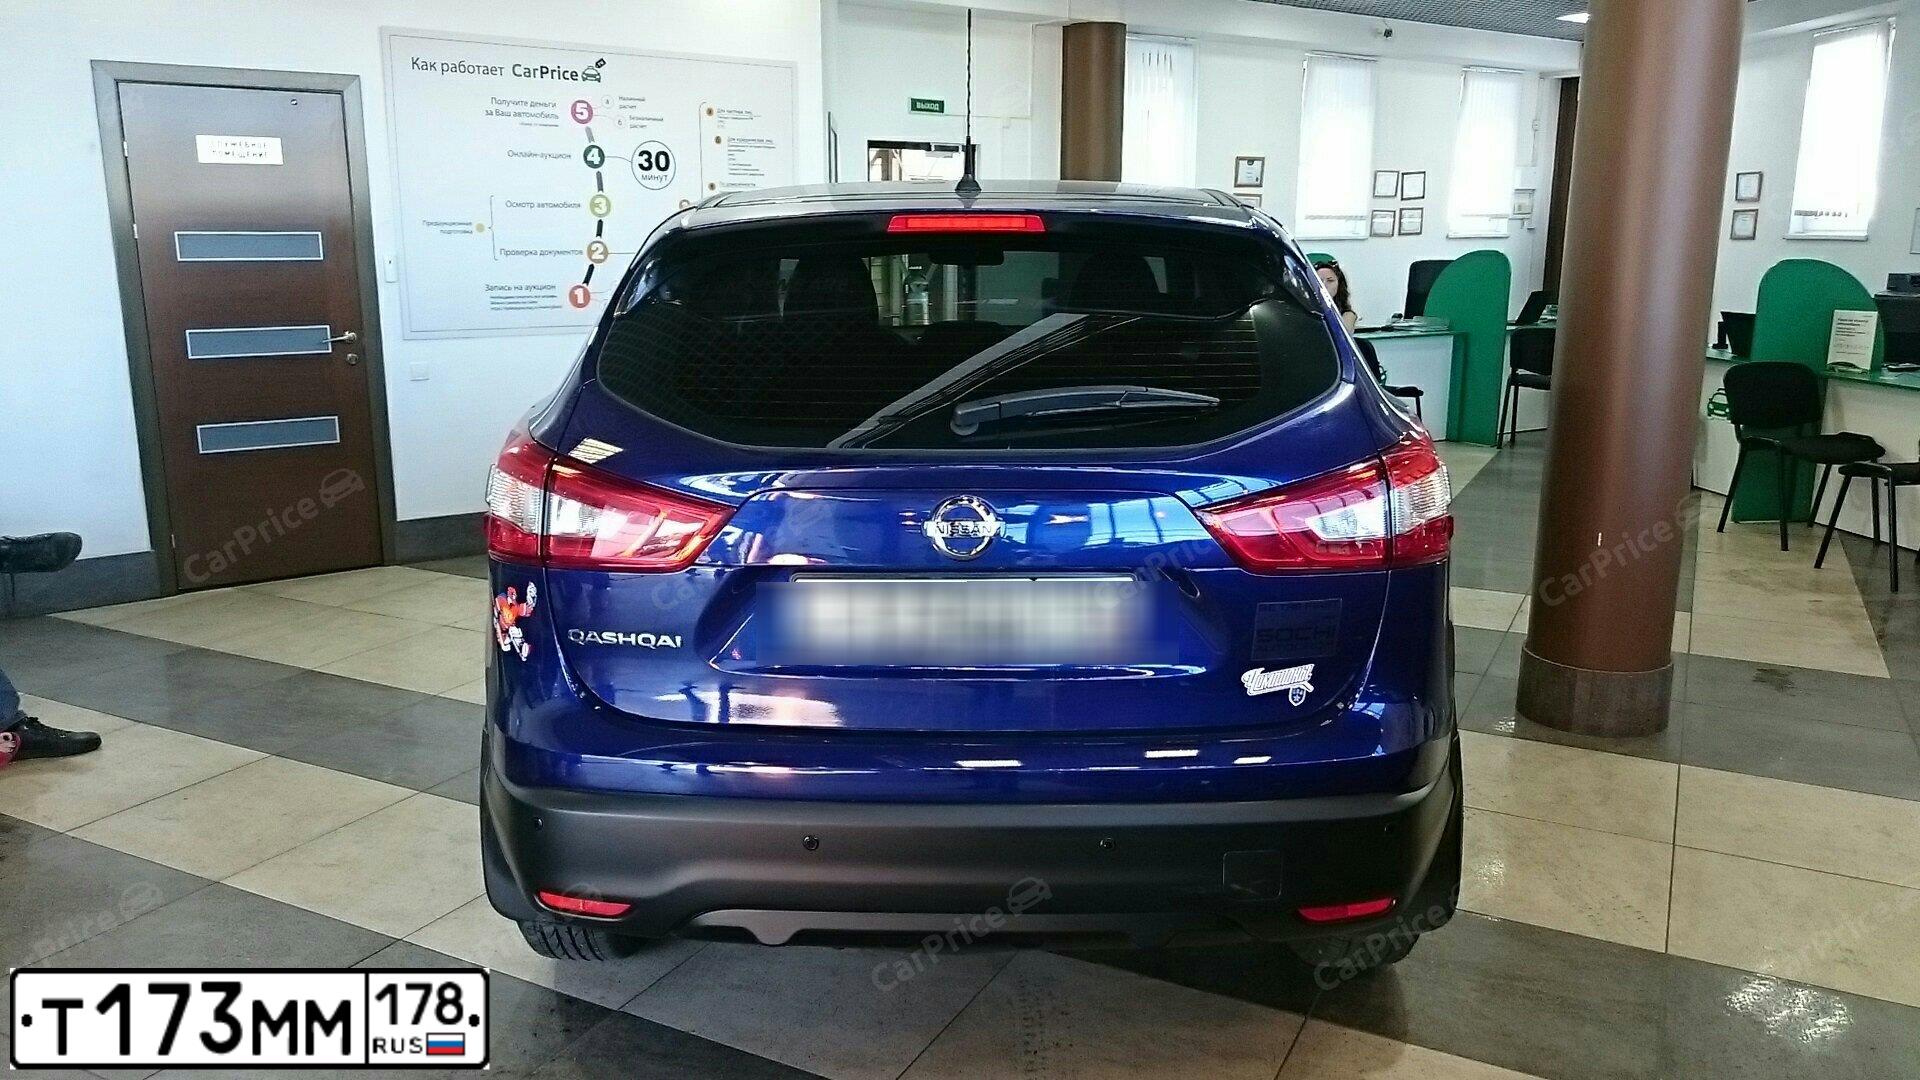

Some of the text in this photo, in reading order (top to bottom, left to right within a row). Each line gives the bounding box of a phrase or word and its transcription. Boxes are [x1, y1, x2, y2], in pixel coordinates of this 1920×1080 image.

[411, 56, 505, 76] Как работает
[512, 63, 579, 81] CarPrice
[491, 97, 529, 108] Получите
[575, 102, 590, 122] 5
[587, 148, 601, 165] 4
[637, 150, 671, 172] 30
[641, 174, 669, 183] минут
[593, 197, 607, 215] 3
[591, 241, 605, 260] 2
[574, 289, 585, 304] 1
[936, 524, 992, 534] NISSAN
[567, 628, 682, 649] QASHQAI
